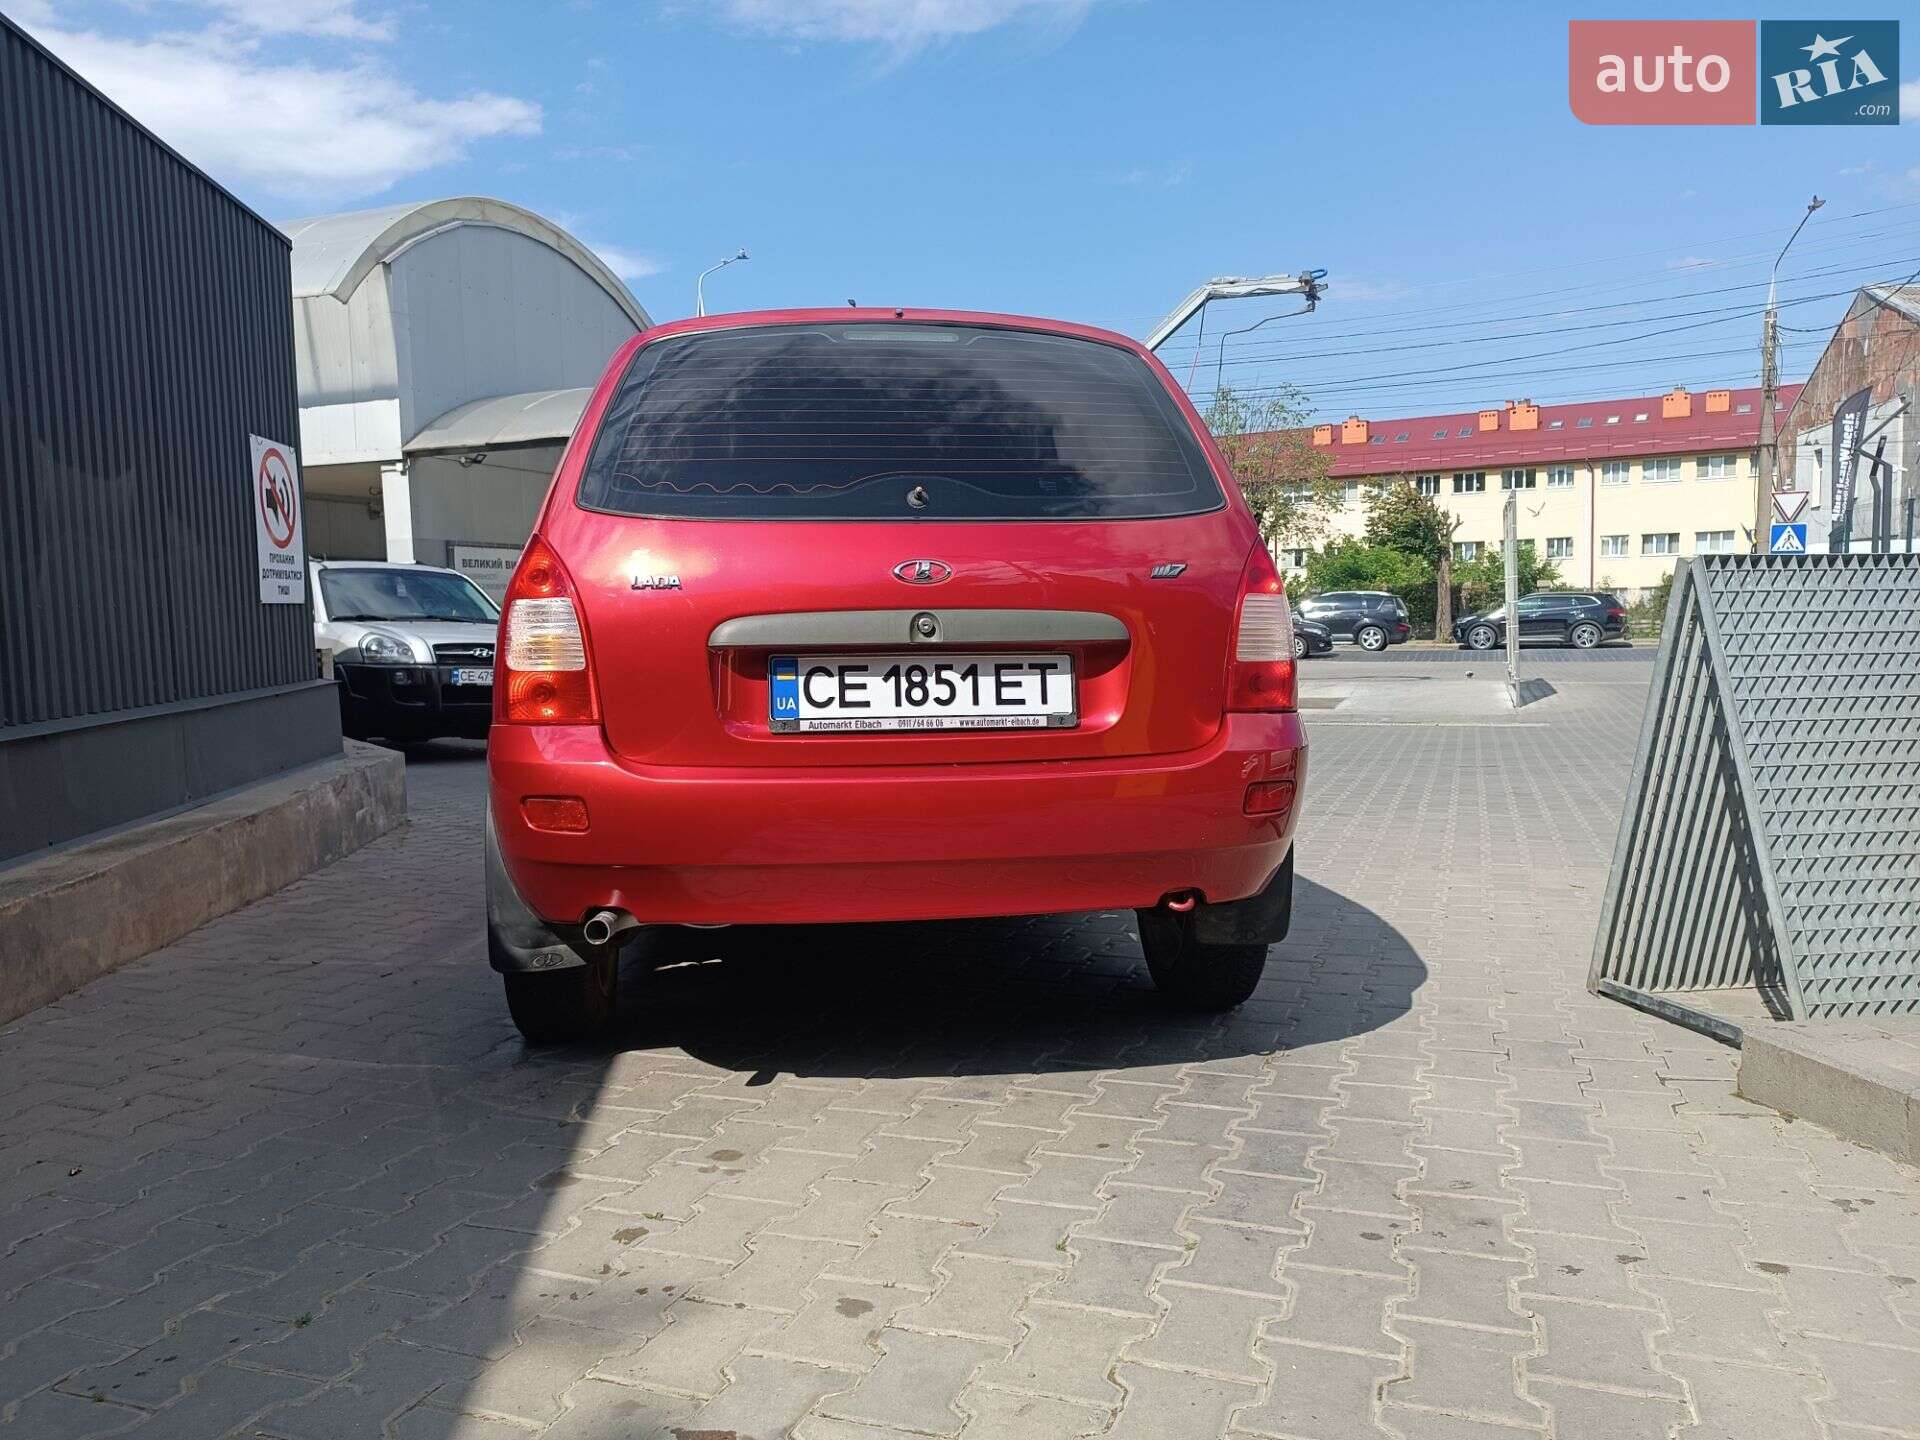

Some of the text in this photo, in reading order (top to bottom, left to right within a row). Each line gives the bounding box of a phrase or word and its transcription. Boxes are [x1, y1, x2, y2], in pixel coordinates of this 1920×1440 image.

[462, 558, 503, 569] ВЕЛИКИЙ
[631, 575, 682, 590] LADA
[460, 670, 475, 682] CE
[803, 663, 1059, 709] CE 1851 ET
[777, 697, 796, 710] UA
[808, 719, 852, 730] Automarkt
[925, 718, 934, 727] 66
[935, 718, 944, 727] 06
